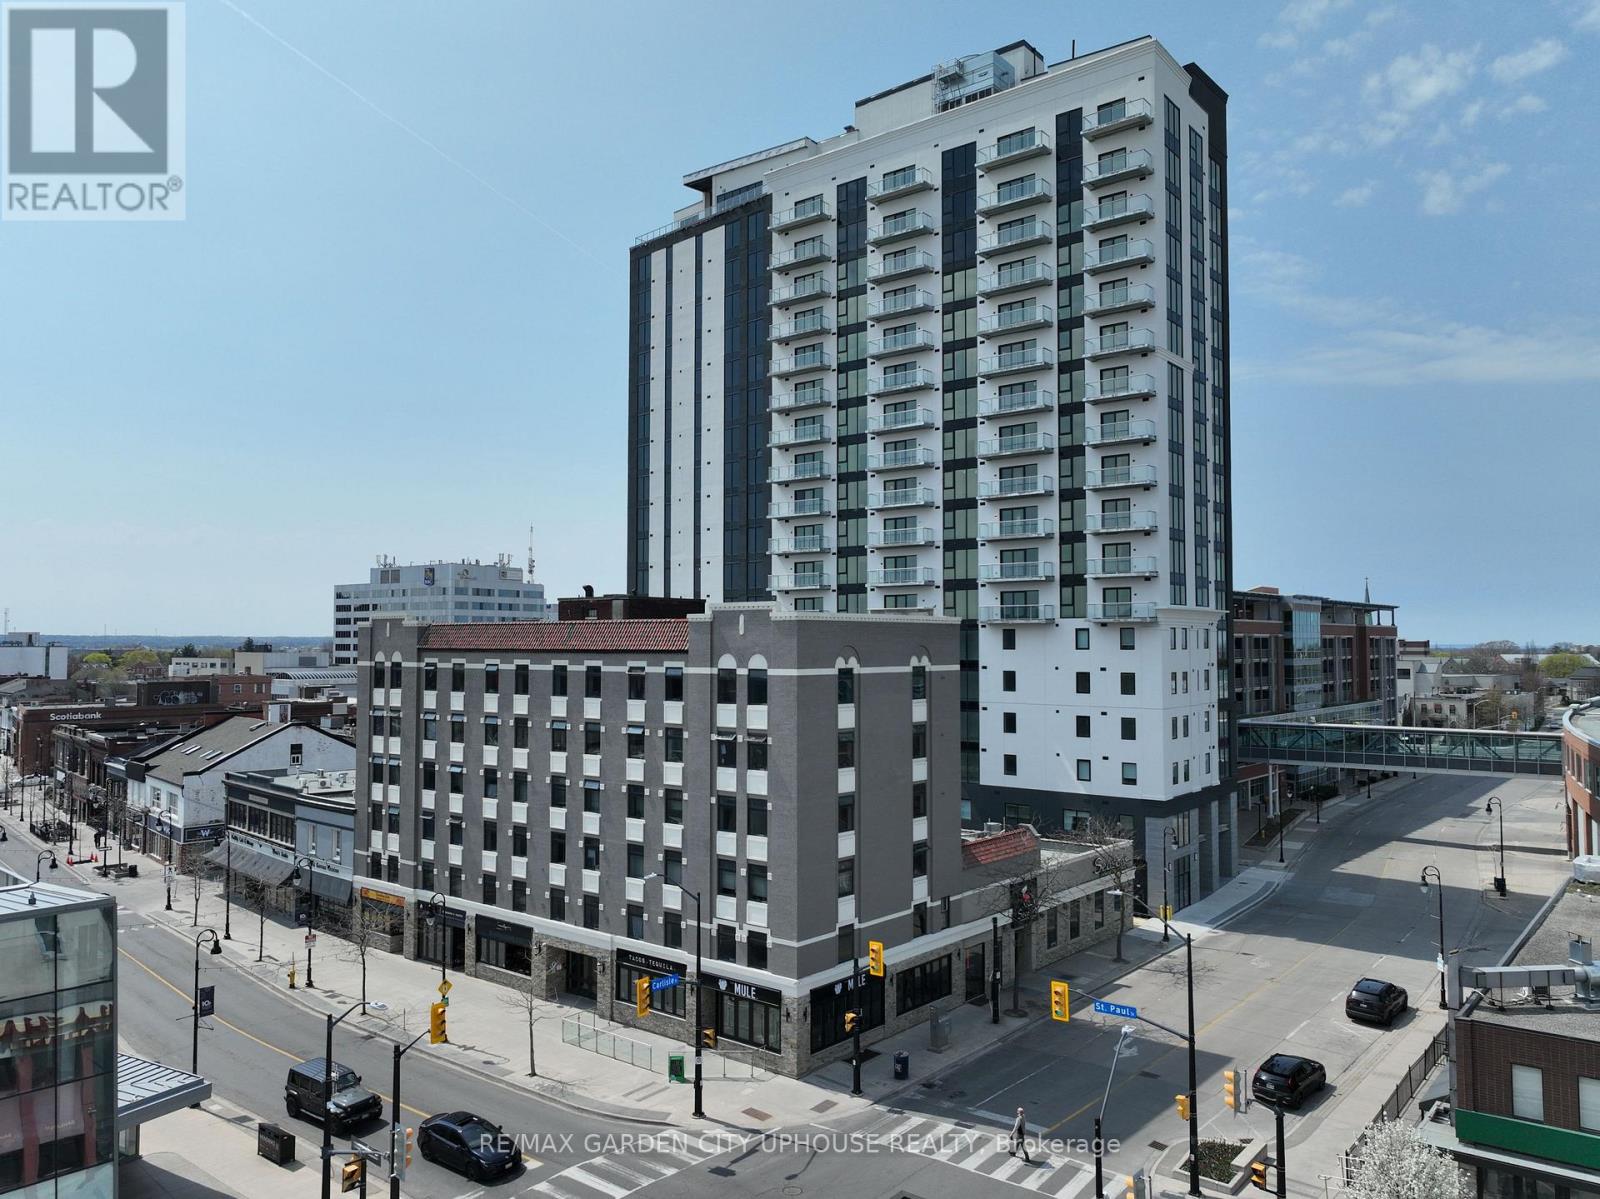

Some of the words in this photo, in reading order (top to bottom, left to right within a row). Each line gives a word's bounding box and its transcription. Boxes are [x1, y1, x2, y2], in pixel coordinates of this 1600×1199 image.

[50, 712, 102, 721] Scotiabank
[848, 974, 866, 991] MLE
[734, 982, 757, 999] MULE
[1110, 1005, 1130, 1015] Paul
